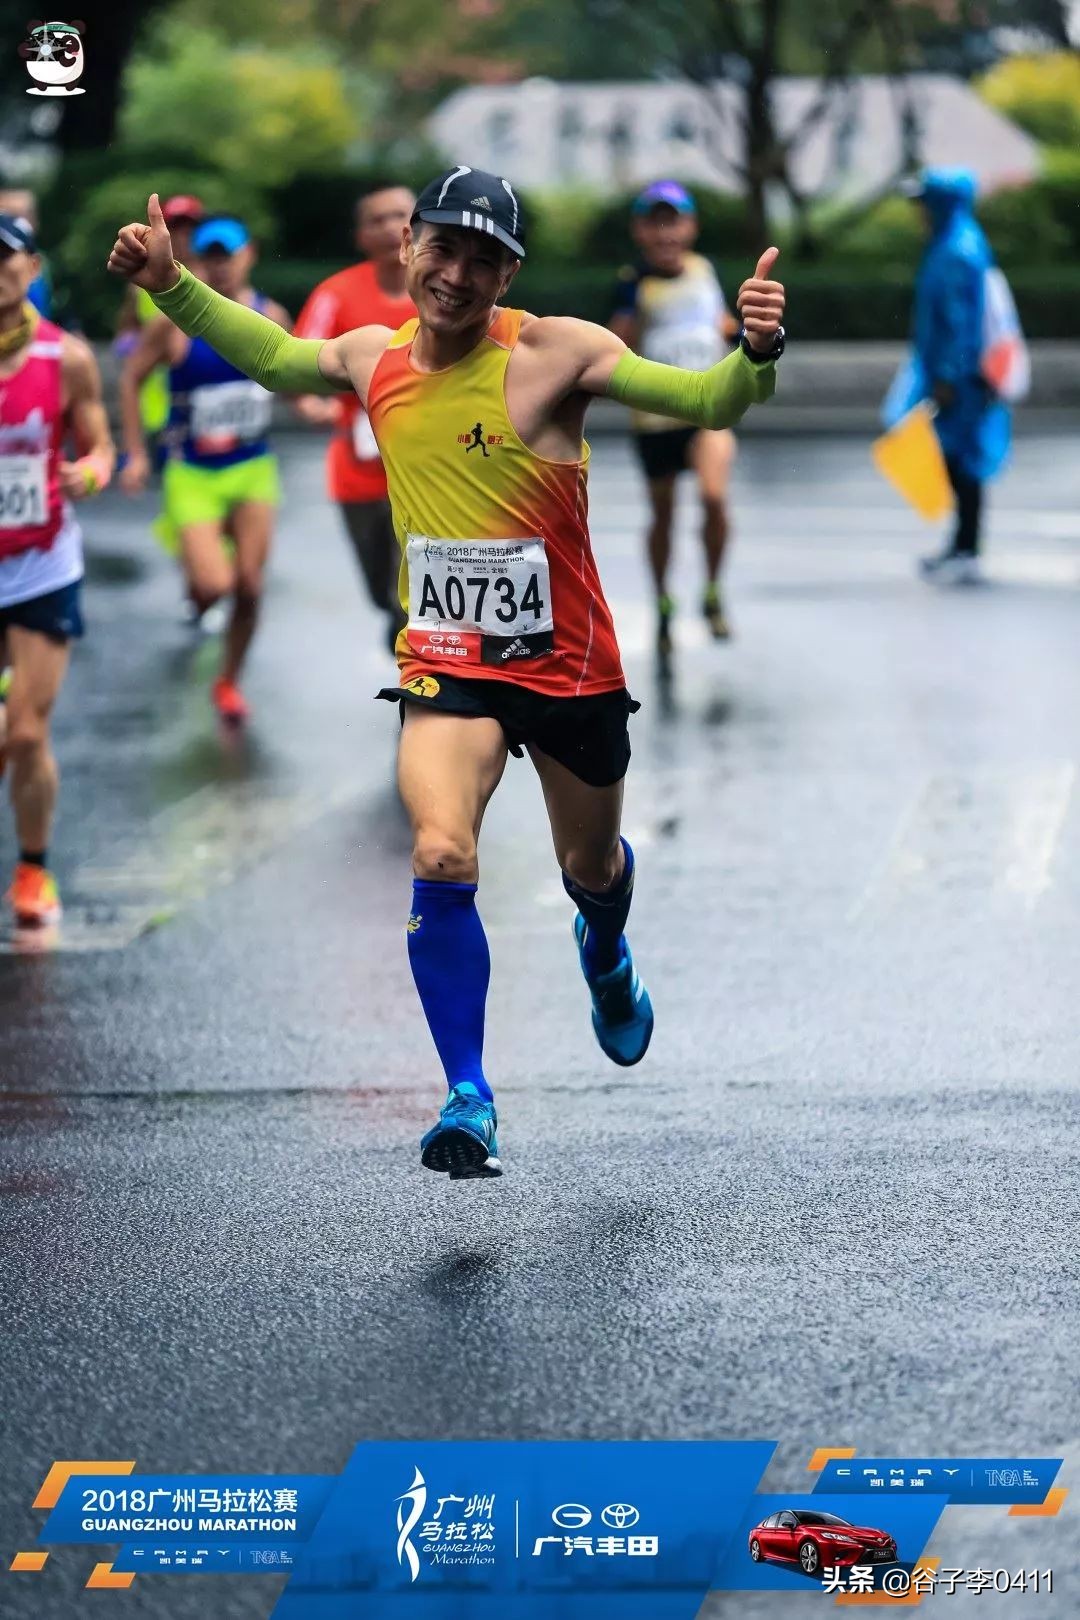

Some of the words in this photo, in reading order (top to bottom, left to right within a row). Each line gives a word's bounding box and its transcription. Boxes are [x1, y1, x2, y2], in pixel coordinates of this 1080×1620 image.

[447, 545, 523, 556] 2018广州马拉松赛
[418, 573, 543, 623] A0734
[420, 645, 468, 656] 广汽丰田
